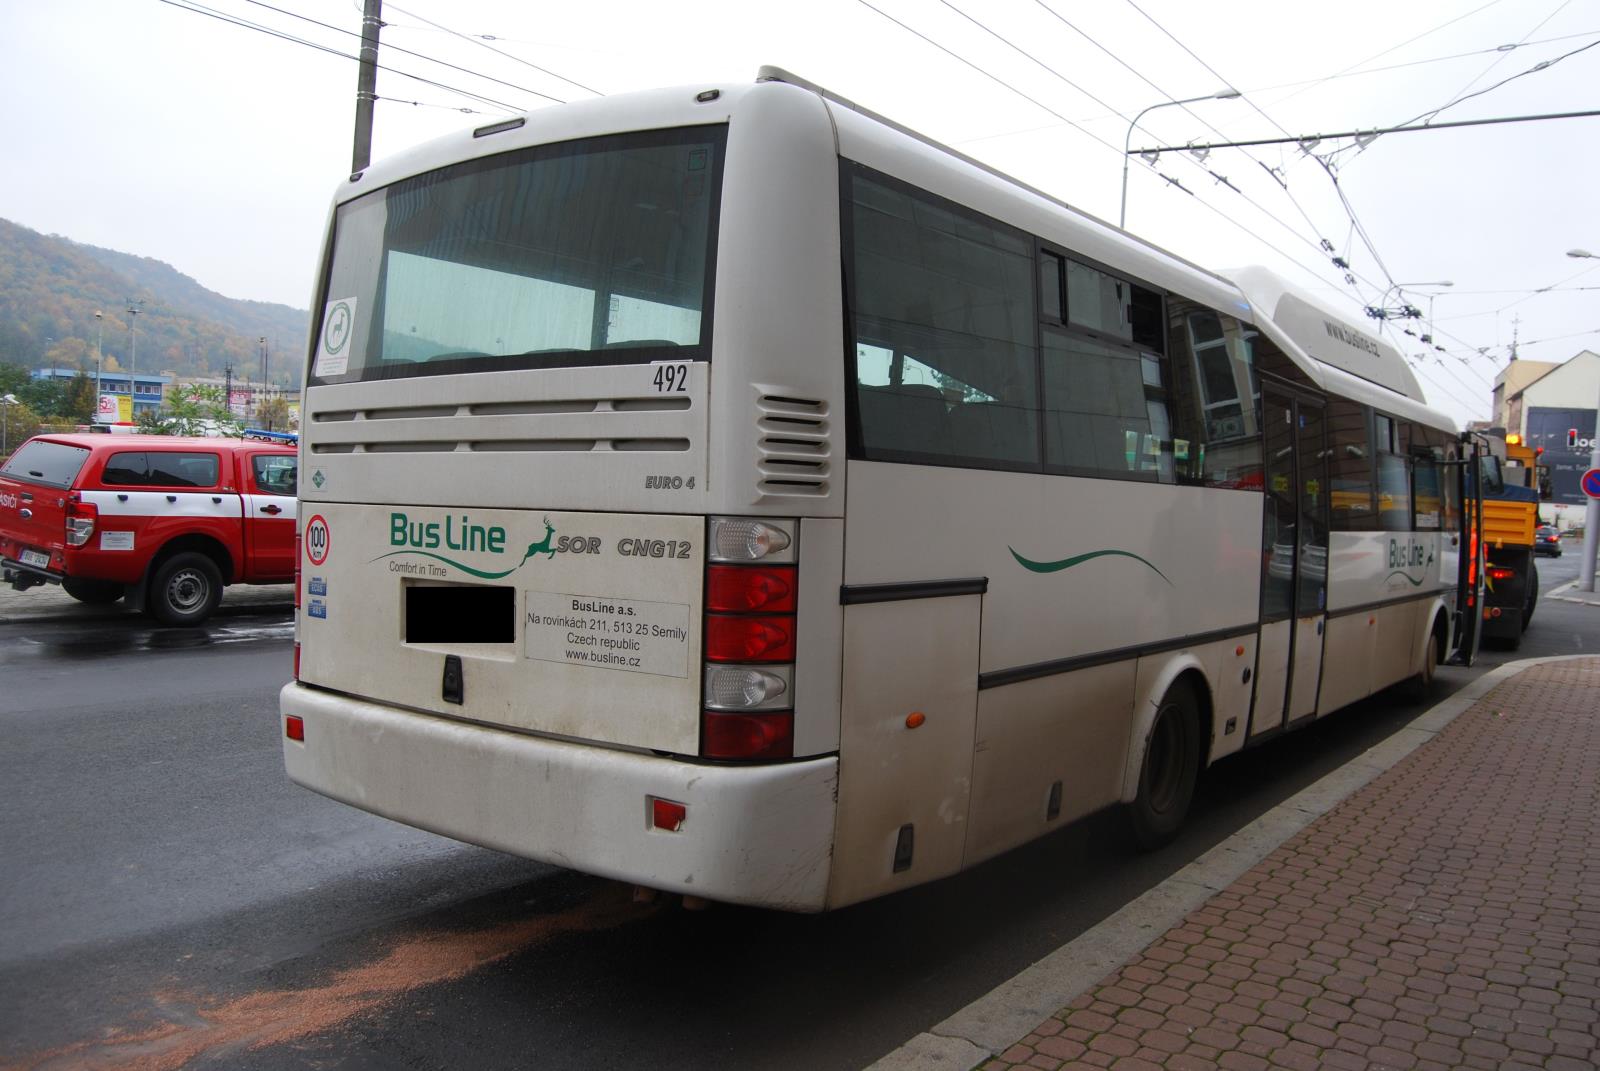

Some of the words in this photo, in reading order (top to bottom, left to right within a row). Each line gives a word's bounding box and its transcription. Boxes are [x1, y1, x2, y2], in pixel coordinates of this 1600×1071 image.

[653, 364, 687, 392] 492
[645, 475, 683, 489] EURO
[685, 476, 696, 489] 4
[310, 526, 326, 548] 100
[557, 535, 602, 554] SOR
[617, 538, 692, 559] CNG12
[389, 560, 418, 574] Comfort
[418, 562, 426, 575] in
[428, 564, 447, 577] Time
[572, 599, 615, 614] BusLine
[617, 606, 637, 616] a.s.
[527, 612, 541, 624] Na
[543, 615, 587, 630] rovinkách
[589, 618, 610, 633] 211,
[613, 621, 633, 634] 513
[635, 623, 649, 635] 25
[651, 625, 688, 643] Semily
[567, 632, 597, 646] Czech
[600, 637, 641, 651] republic
[565, 649, 641, 667] www.busline.cz
